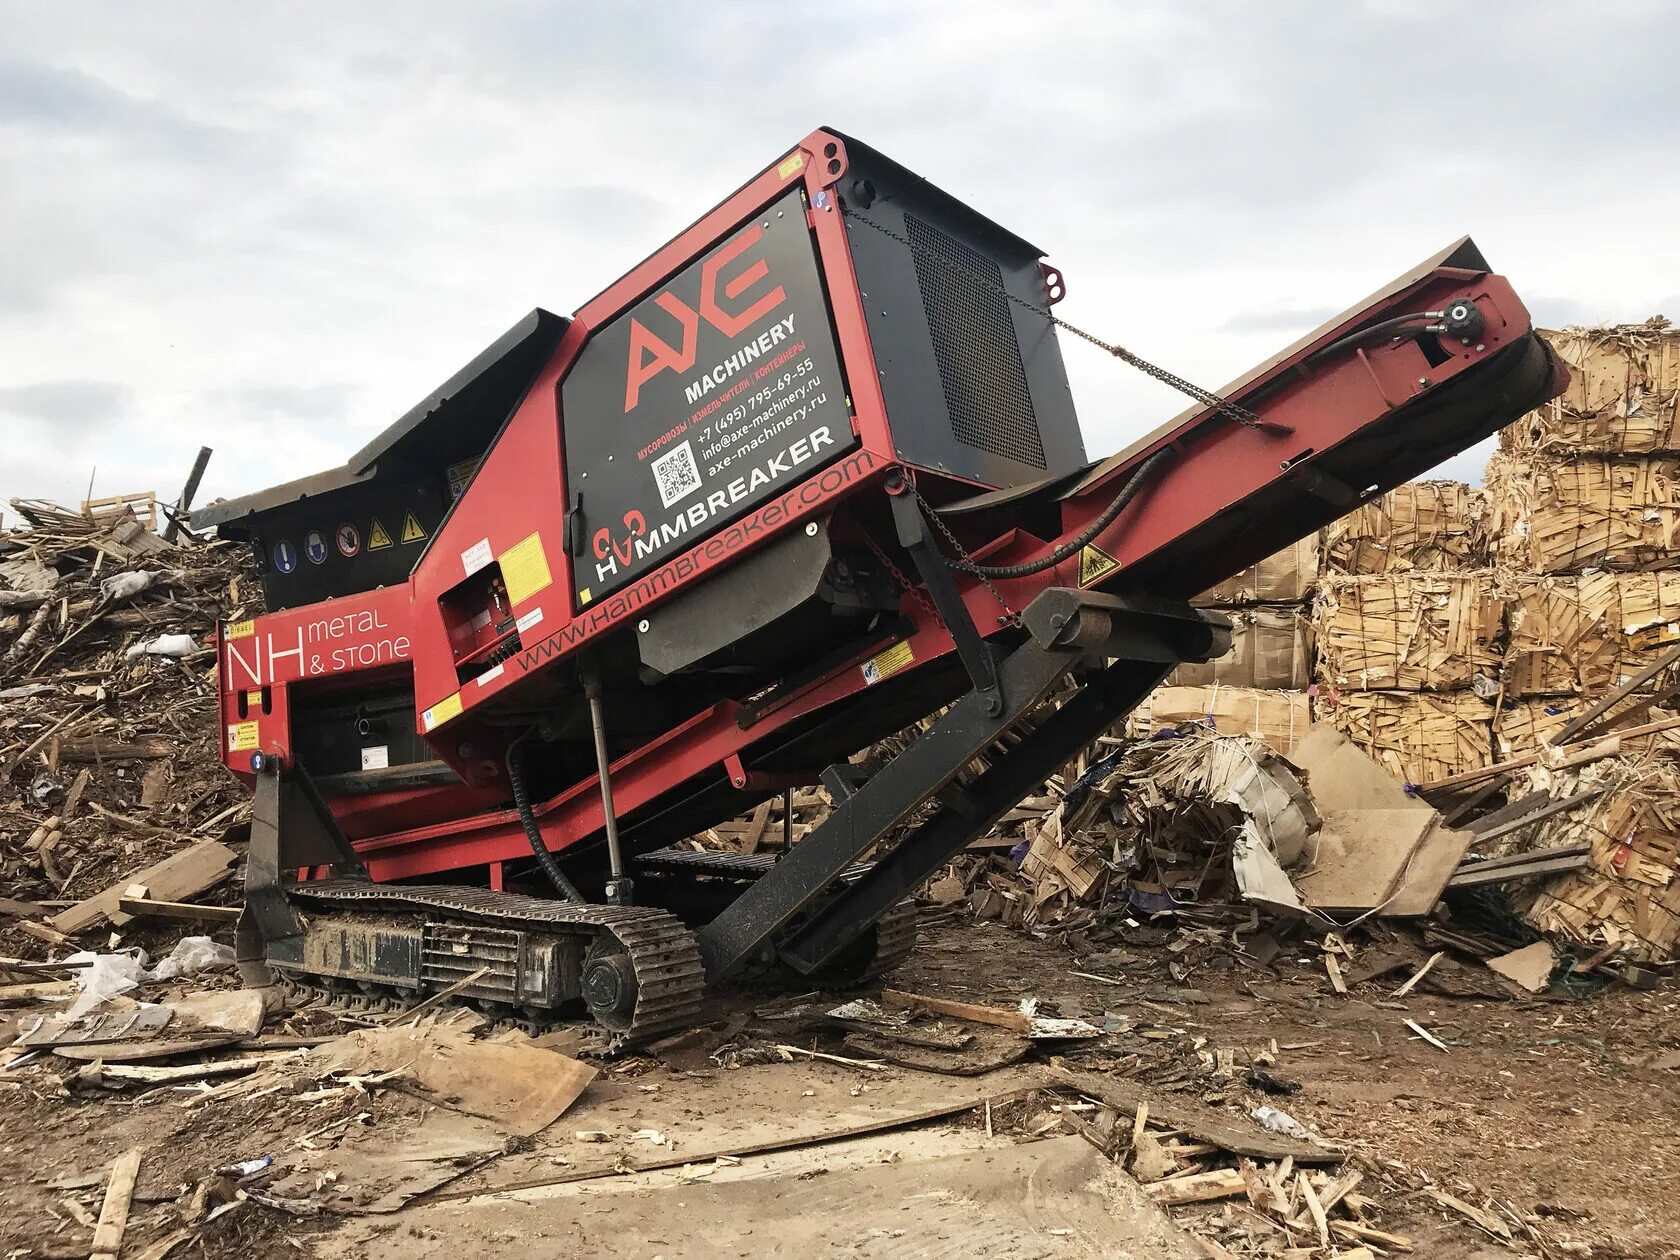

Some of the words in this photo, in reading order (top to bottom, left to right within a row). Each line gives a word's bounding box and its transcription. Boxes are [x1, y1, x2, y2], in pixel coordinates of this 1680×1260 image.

[624, 223, 787, 413] AXE
[684, 313, 796, 405] MACHINERY
[636, 422, 687, 461] МУСОРОВОЗЫ
[691, 378, 750, 424] ИЗМЕЛЬЧИТЕЛИ
[697, 428, 712, 444] +7
[715, 405, 747, 435] (495)
[748, 357, 814, 411] 795-69-55
[701, 375, 822, 461] info@axe-machinery.ru
[708, 391, 827, 477] axe-machinery.ru
[227, 626, 305, 691] NH
[230, 624, 252, 634] DIESEL
[309, 655, 325, 675] &
